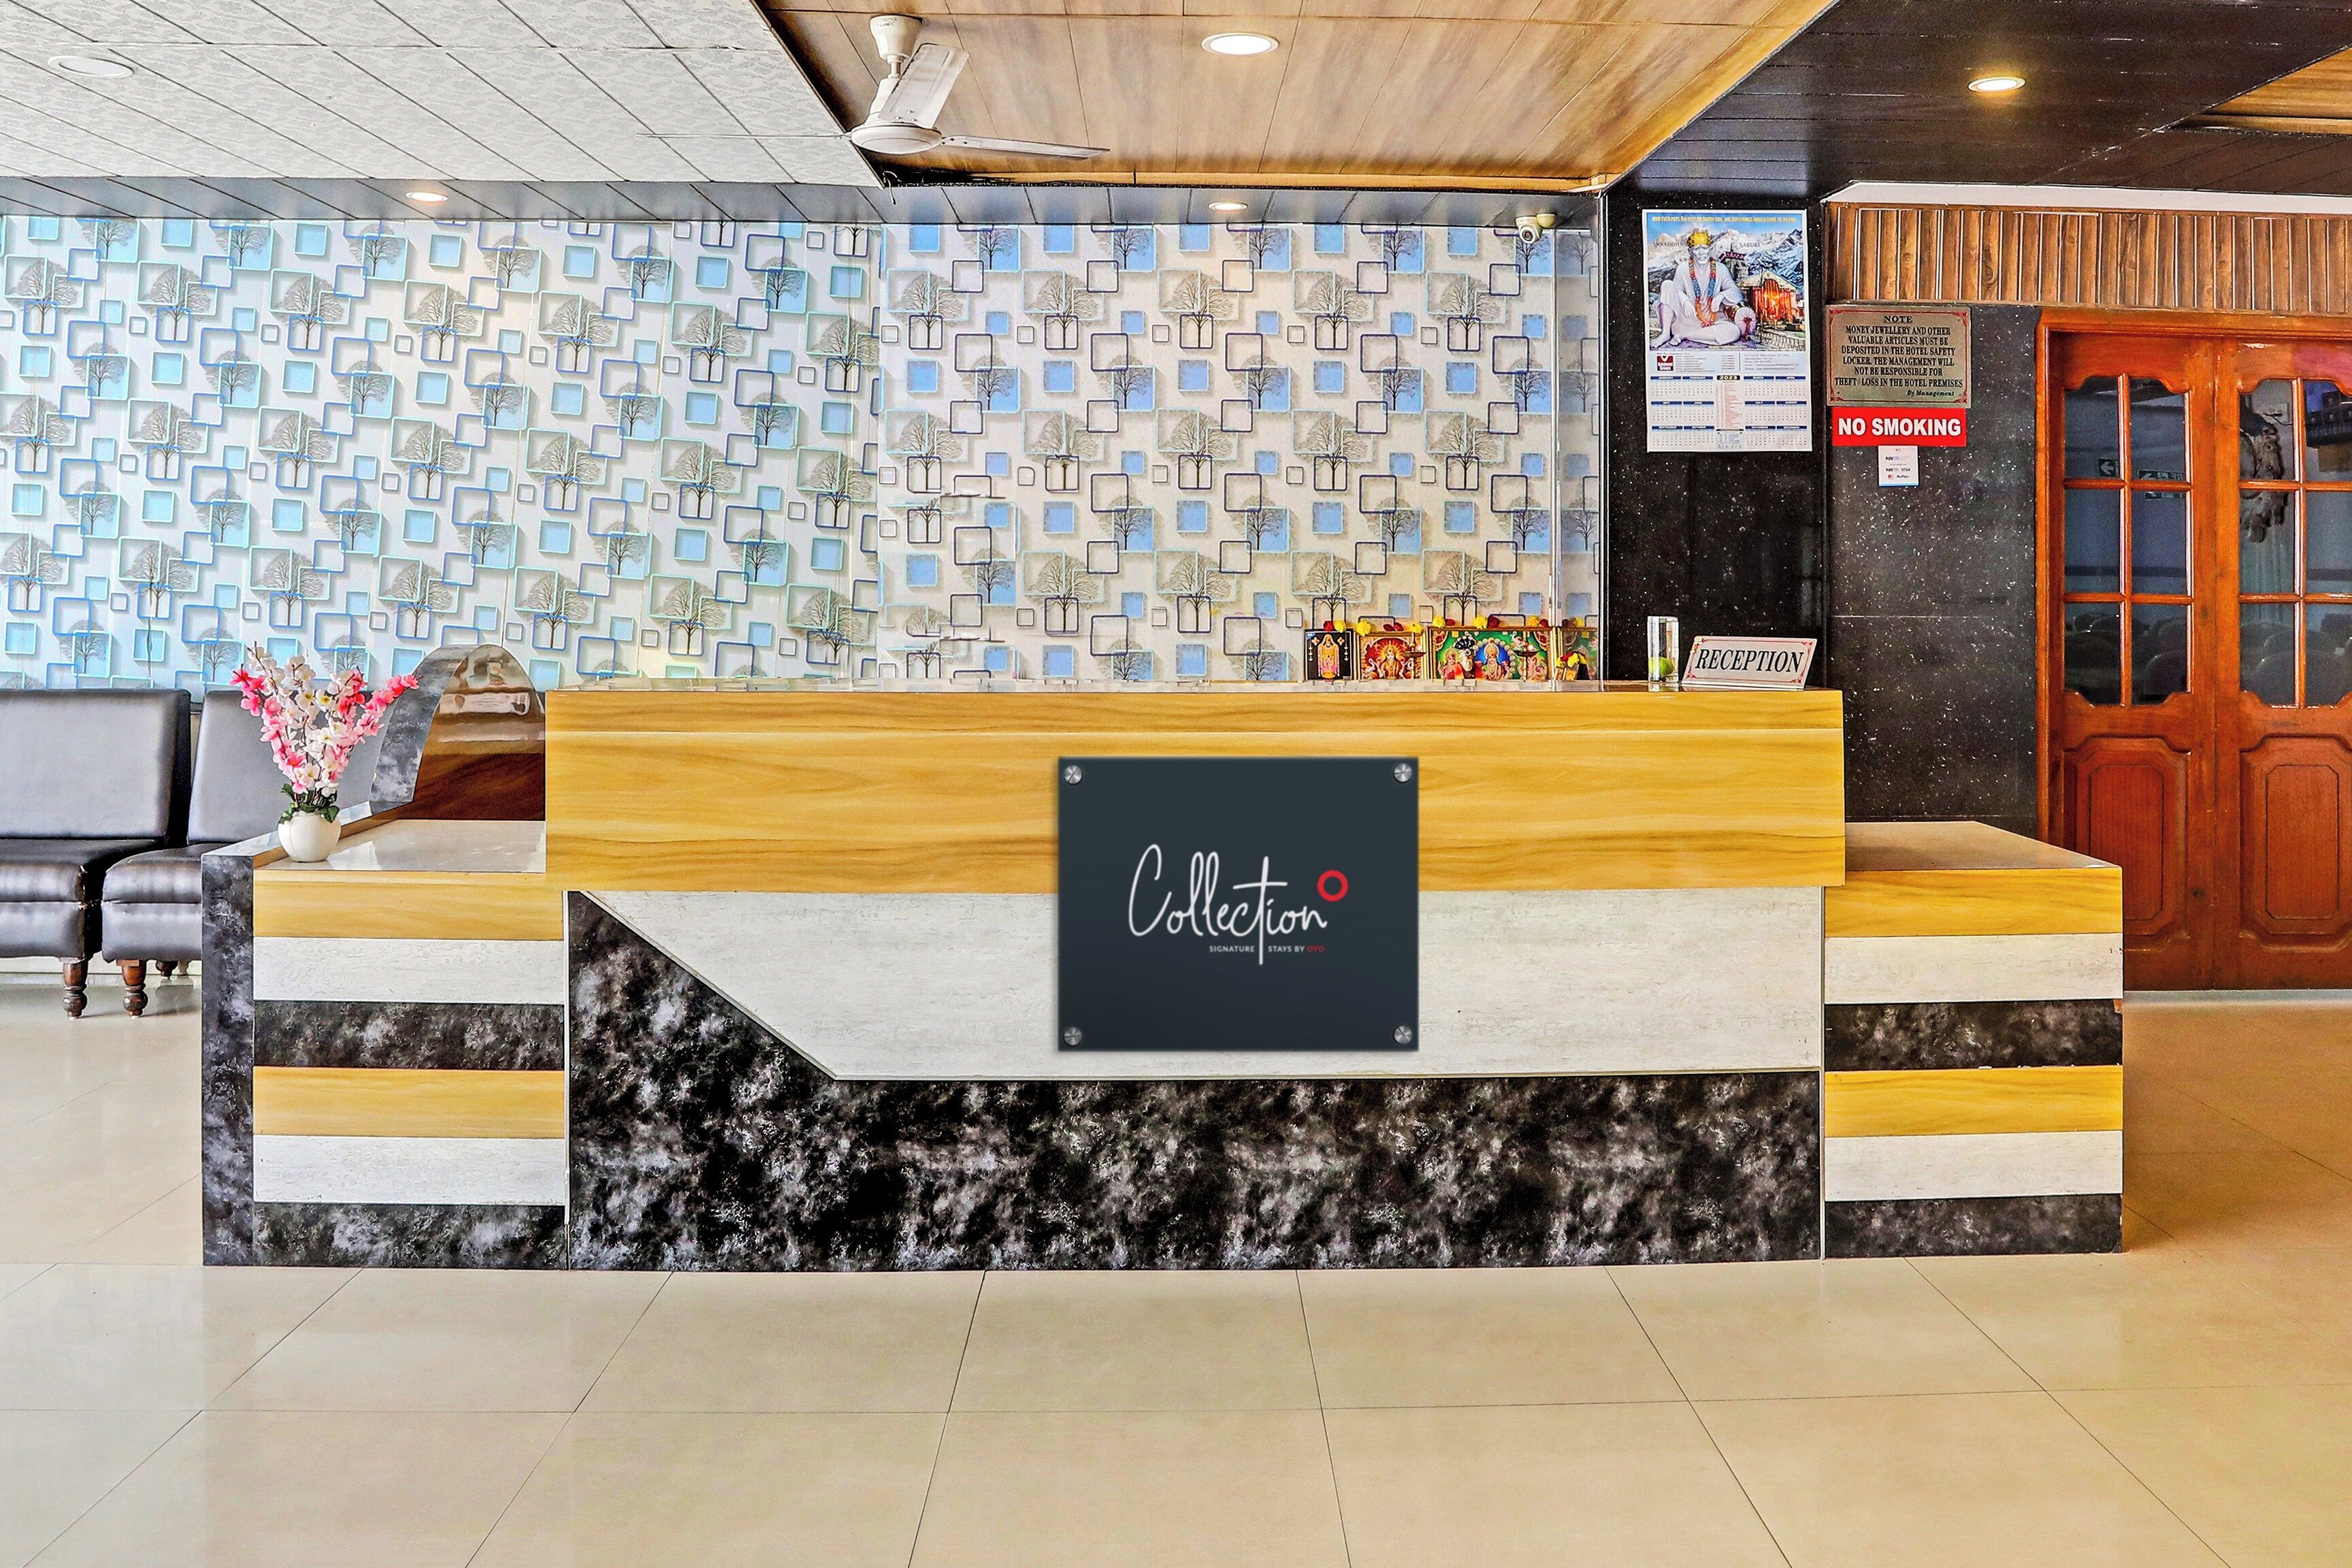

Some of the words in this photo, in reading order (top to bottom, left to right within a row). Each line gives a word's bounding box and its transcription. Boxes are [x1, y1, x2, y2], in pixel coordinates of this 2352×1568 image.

[1845, 325, 1870, 334] MONEY
[1871, 326, 1910, 334] JEWELLERY
[1912, 327, 1927, 335] AND
[1927, 327, 1950, 336] OTHER
[1848, 336, 1883, 344] VALUABLE
[1884, 336, 1918, 345] ARTICLES
[1919, 337, 1938, 346] MUST
[1940, 338, 1948, 346] BE
[1842, 346, 1880, 354] DEPOSITED
[1882, 346, 1889, 355] IN
[1891, 346, 1904, 355] THE
[1906, 347, 1929, 355] HOTEL
[1930, 347, 1955, 356] SAFETY
[1874, 357, 1887, 365] THE
[1889, 357, 1936, 366] MANAGEMENT
[1938, 358, 1955, 366] WILL
[1855, 367, 1869, 375] NOT
[1880, 368, 1927, 376] RESPONSIBLE
[1929, 368, 1942, 376] FOR
[1835, 377, 1857, 386] THEFT
[1862, 378, 1879, 386] LOSS
[1880, 378, 1888, 387] IN
[1889, 378, 1903, 387] THE
[1904, 379, 1927, 387] HOTEL
[1929, 379, 1963, 388] PREMISES
[1838, 418, 1866, 436] NO
[1872, 418, 1961, 436] SMOKING
[1695, 649, 1804, 672] RECEPTION
[1128, 843, 1328, 965] Collection
[1307, 945, 1325, 953] OYO
